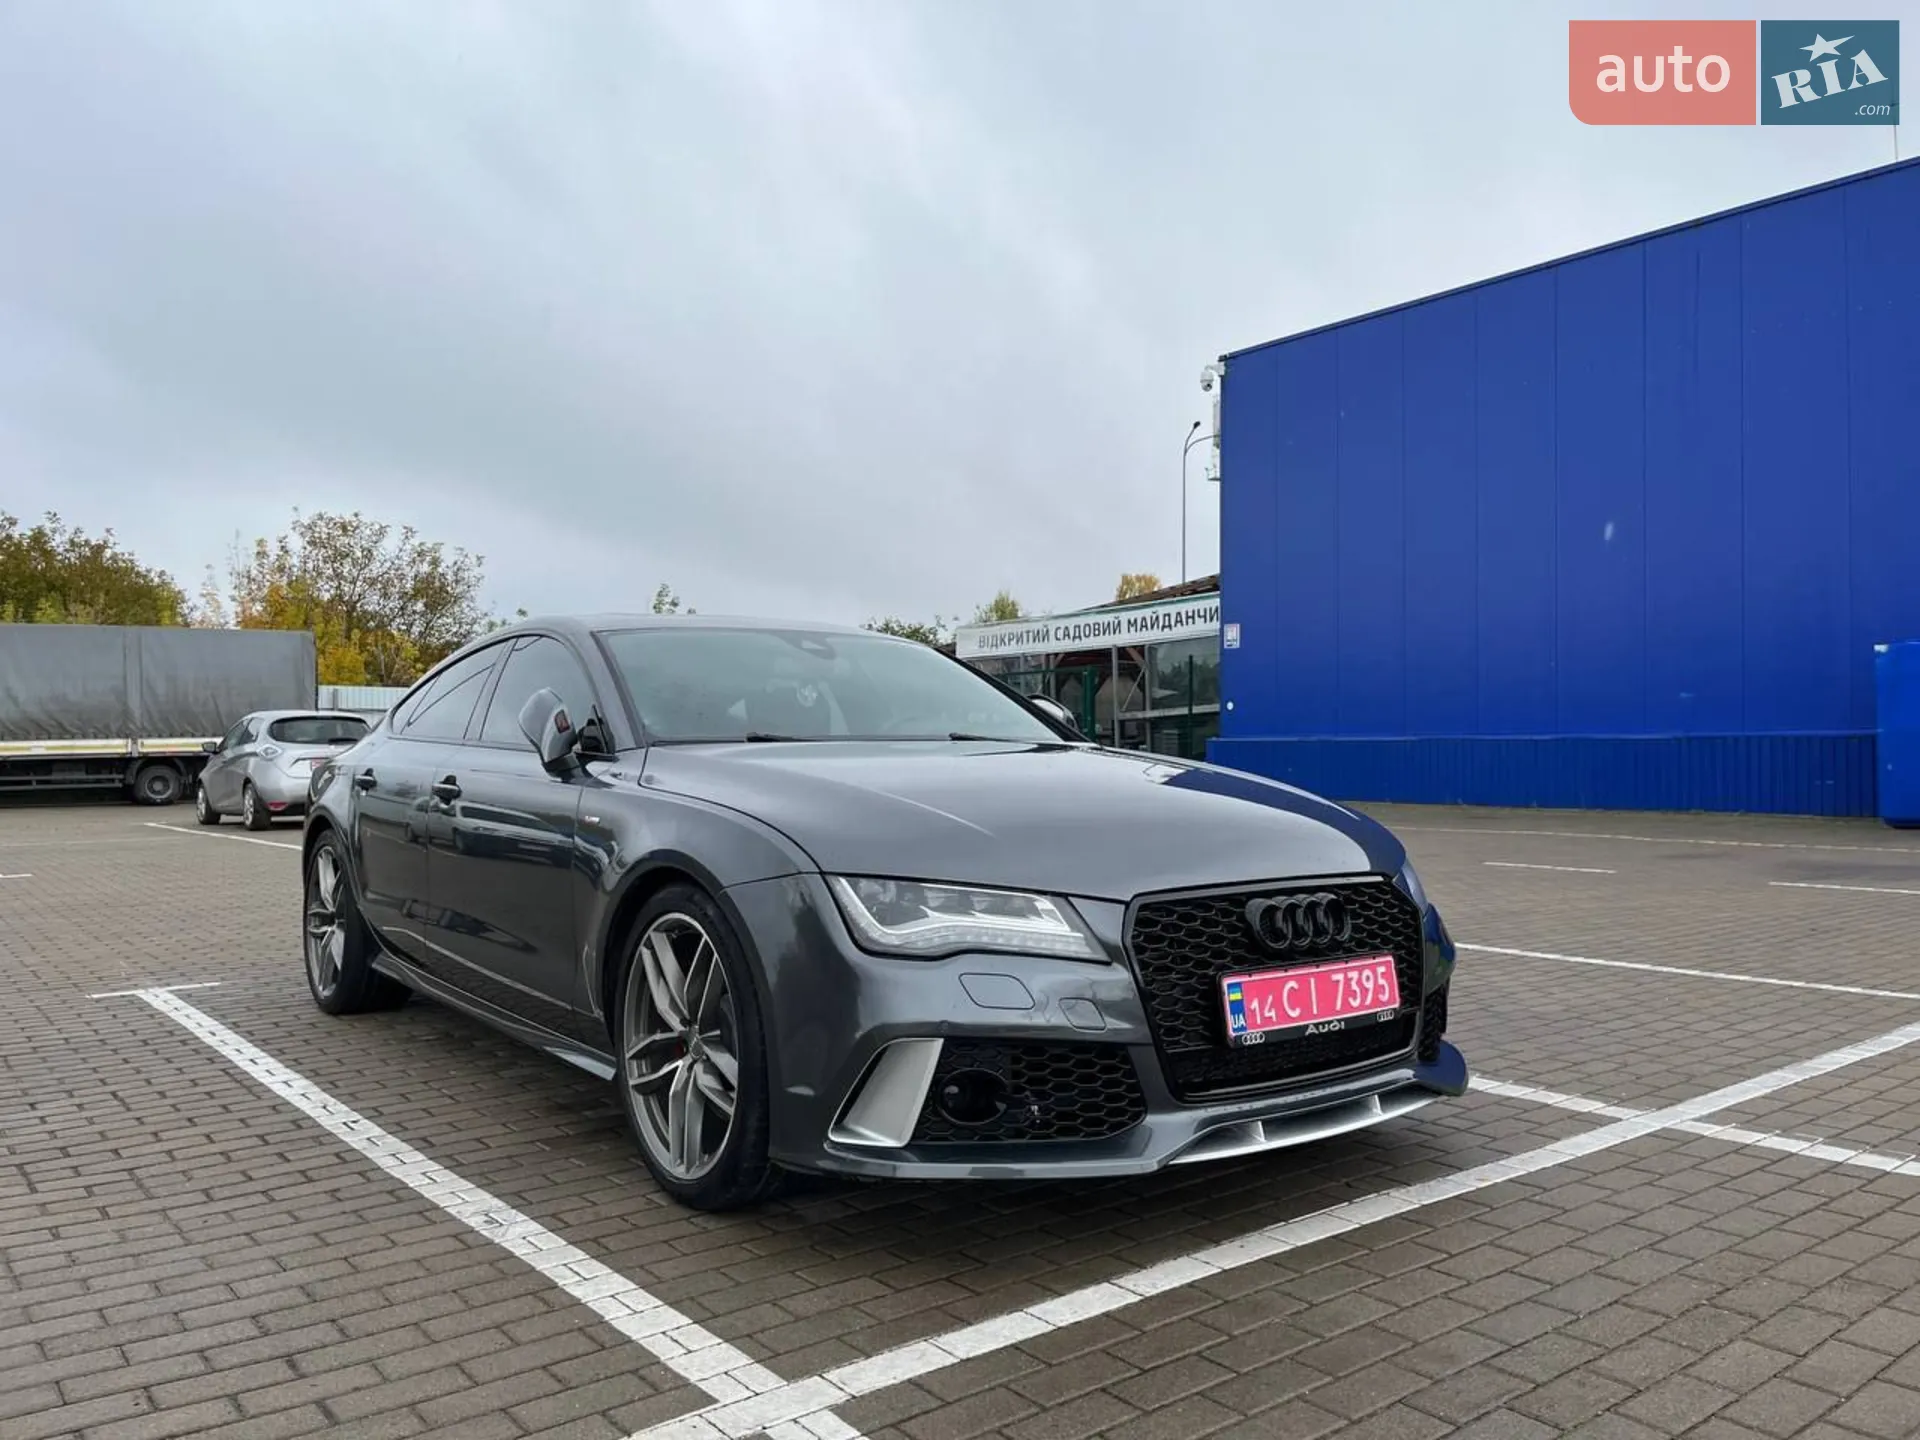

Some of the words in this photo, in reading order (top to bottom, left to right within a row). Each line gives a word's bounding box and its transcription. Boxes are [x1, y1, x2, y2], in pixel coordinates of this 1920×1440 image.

[979, 625, 1050, 649] ВІДКРИТИЙ
[1054, 616, 1122, 642] САДОВИЙ
[1127, 605, 1219, 633] МАЙДАНЧИ
[1331, 966, 1390, 1012] 7395
[1231, 1013, 1247, 1029] UA
